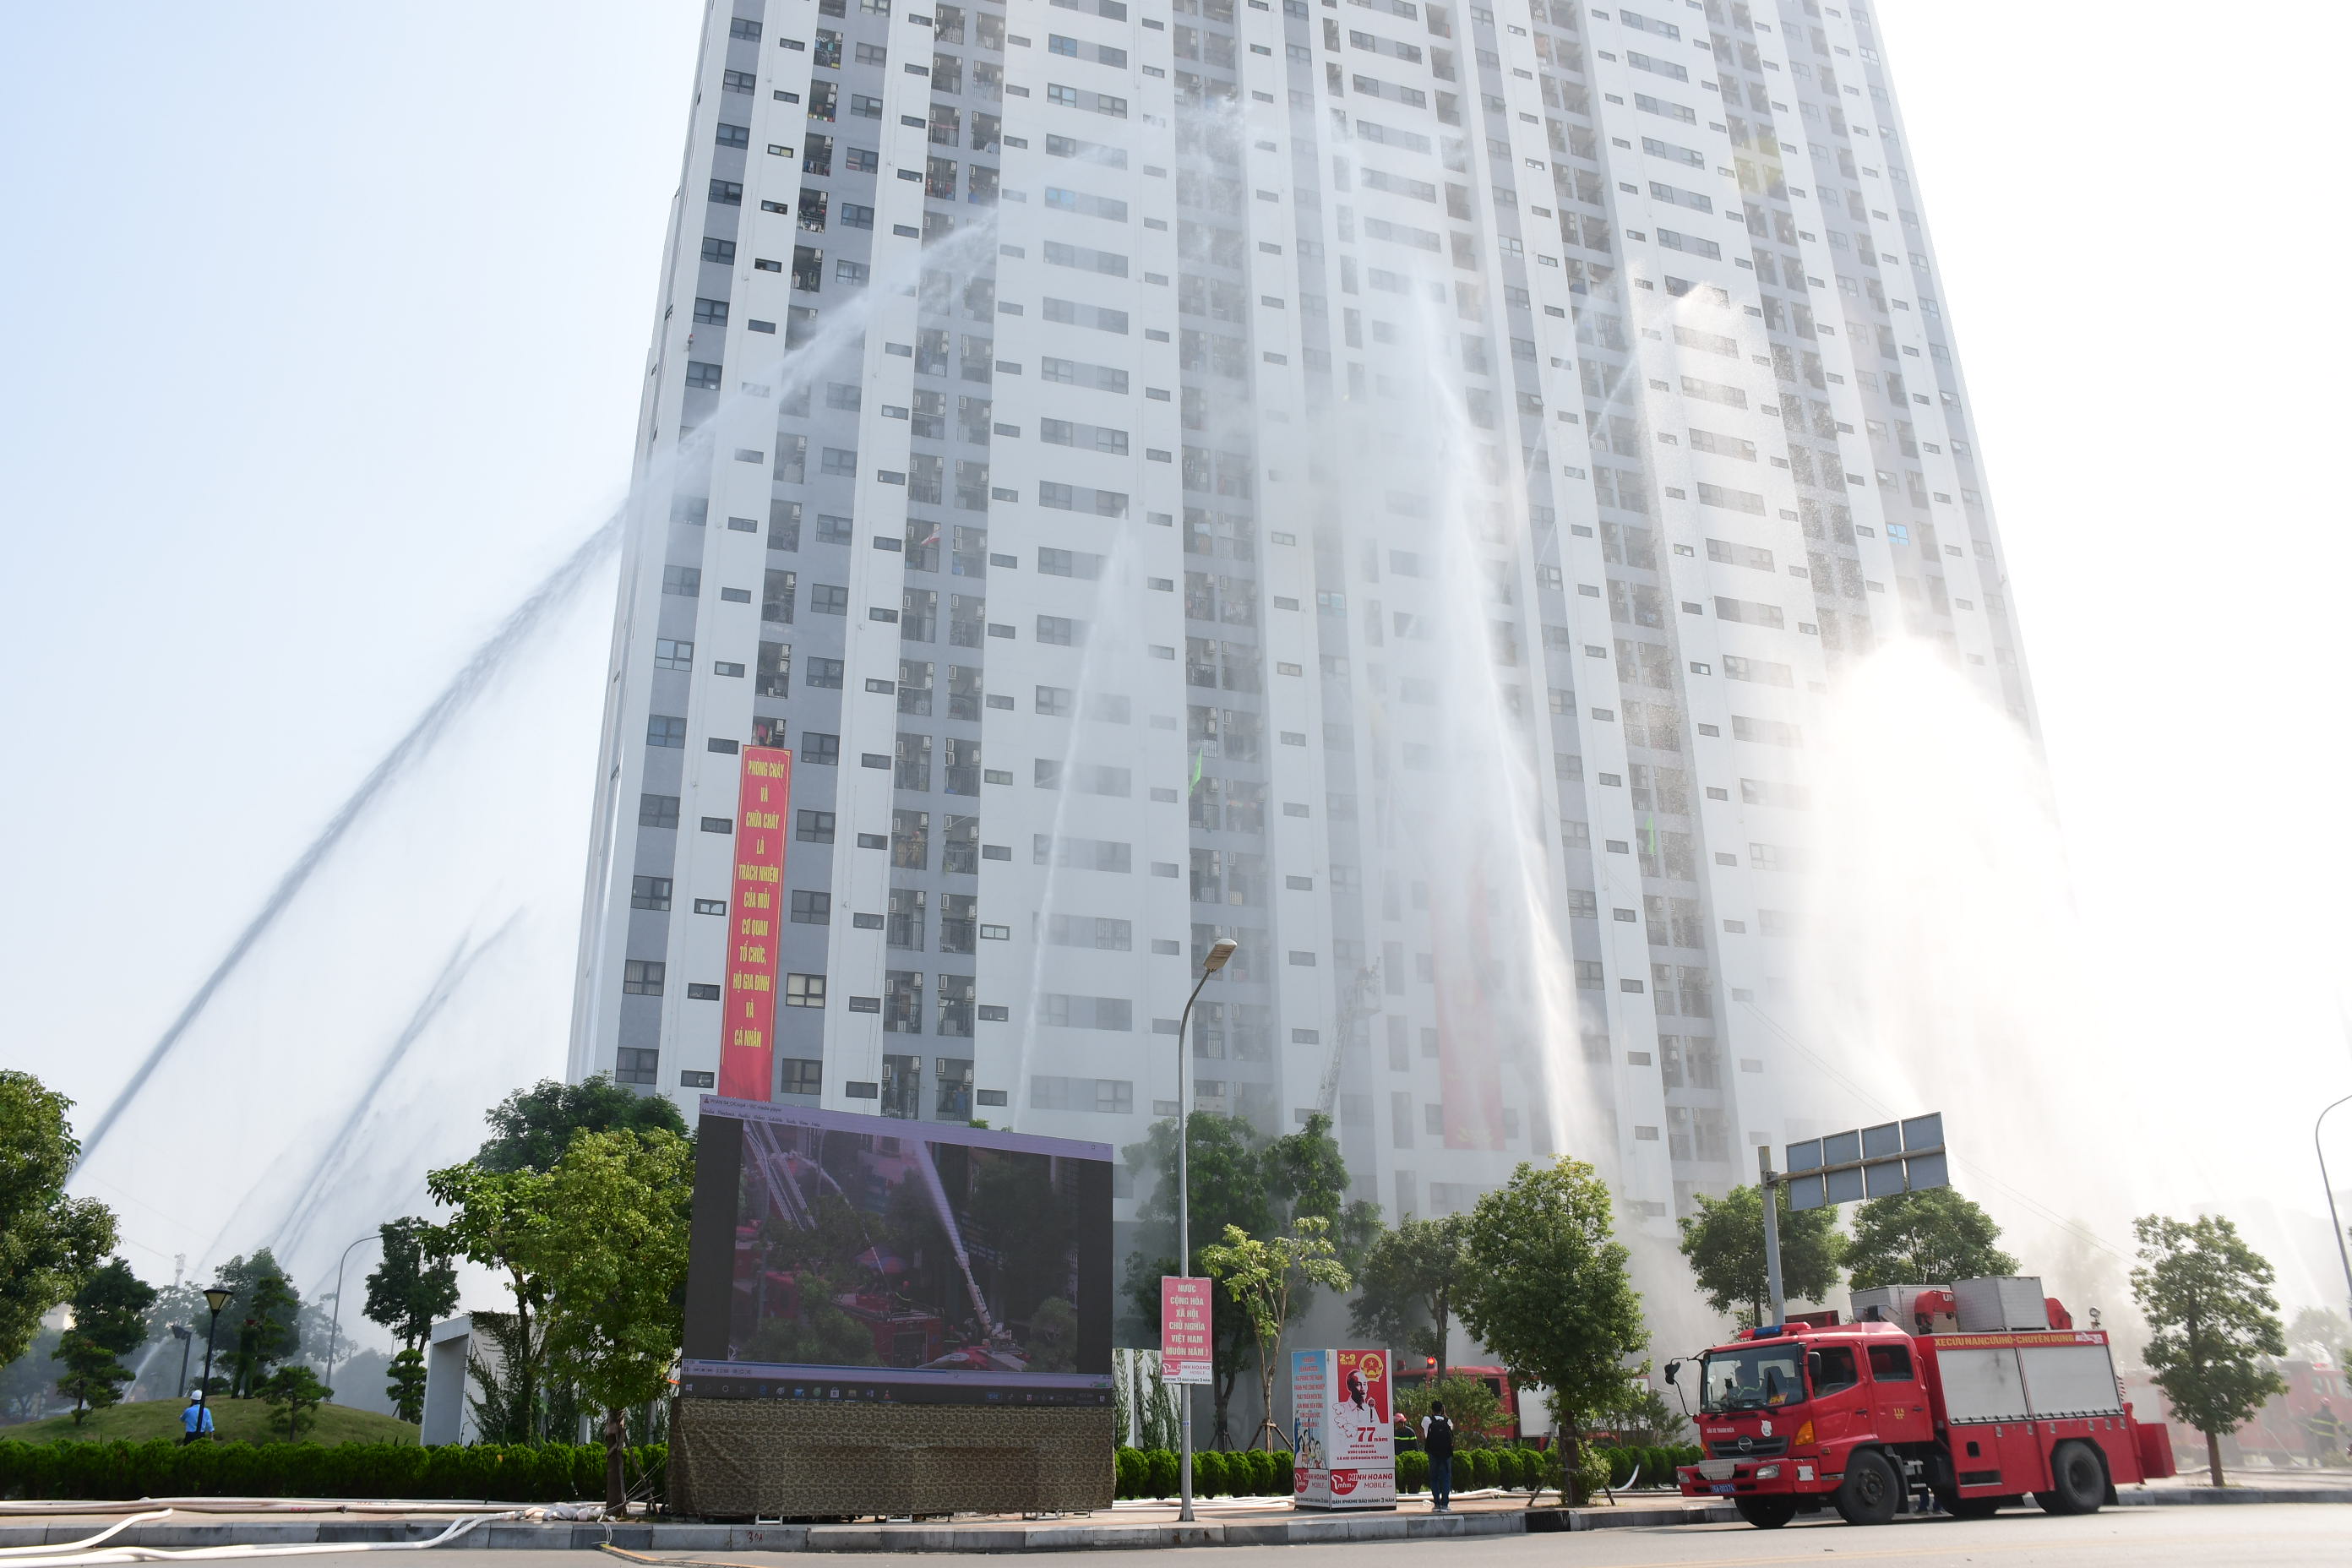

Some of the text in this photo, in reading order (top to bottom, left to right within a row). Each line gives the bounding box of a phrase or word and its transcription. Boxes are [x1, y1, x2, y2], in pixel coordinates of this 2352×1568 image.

[748, 757, 785, 779] PHÒNG CHÁY
[760, 784, 769, 803] VÀ
[746, 808, 780, 829] CHỮA CHÁY
[756, 836, 765, 855] LÀ
[738, 861, 780, 885] TRÁCH NHIỆM
[743, 887, 756, 908] CỦA
[741, 917, 769, 937] CƠ QUAN
[732, 970, 770, 994] HỘ GIA ĐÌNH
[745, 999, 754, 1019] VÀ
[734, 1026, 762, 1048] CÁ NHÂN
[1178, 1283, 1196, 1293] NƯỚC
[1170, 1295, 1204, 1306] CỘNG HÒA
[1176, 1308, 1199, 1319] XÃ HỘI
[1168, 1320, 1183, 1330] CHỦ
[1171, 1334, 1203, 1344] VIỆT NAM
[1166, 1346, 1187, 1356] MUÔN
[1188, 1346, 1204, 1356] NĂM
[1357, 1427, 1375, 1442] 77
